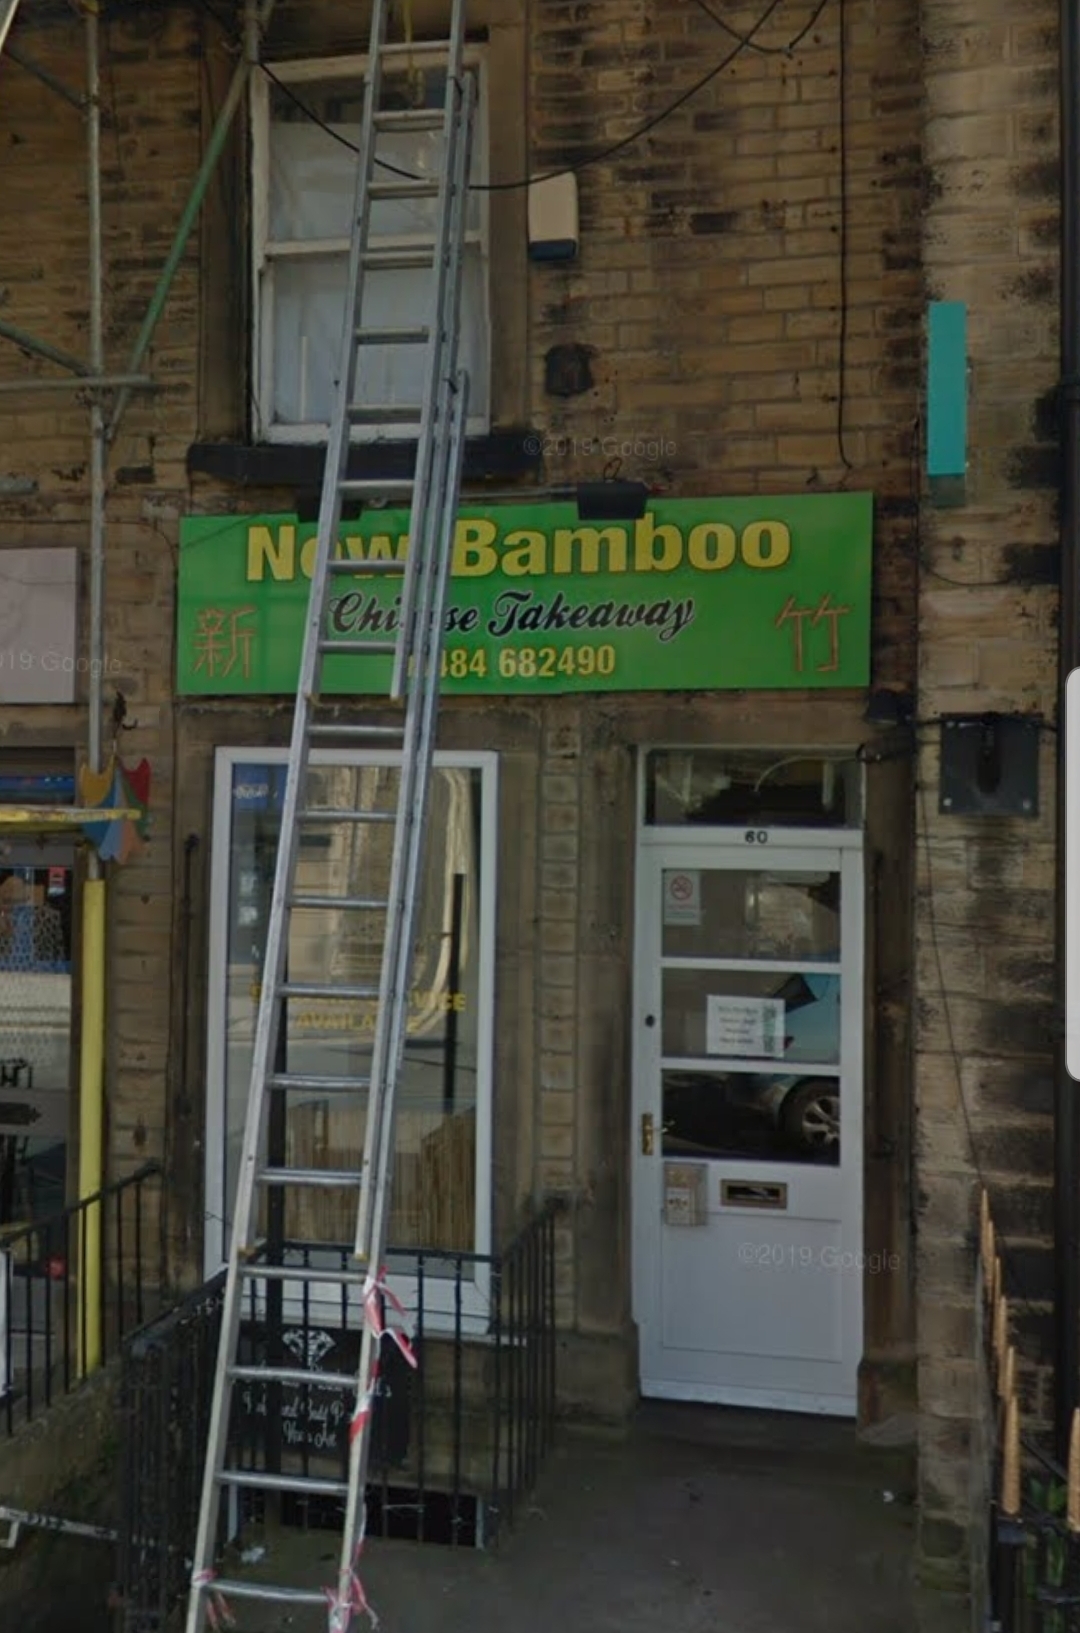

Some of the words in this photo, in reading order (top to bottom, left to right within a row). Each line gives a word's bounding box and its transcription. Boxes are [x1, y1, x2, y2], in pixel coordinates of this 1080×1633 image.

[450, 511, 792, 577] Bamboo
[193, 605, 257, 679] 新
[330, 592, 478, 633] Chise
[487, 590, 695, 642] Takeaway
[775, 592, 852, 673] 竹
[499, 645, 616, 678] 682490
[744, 830, 768, 844] 60
